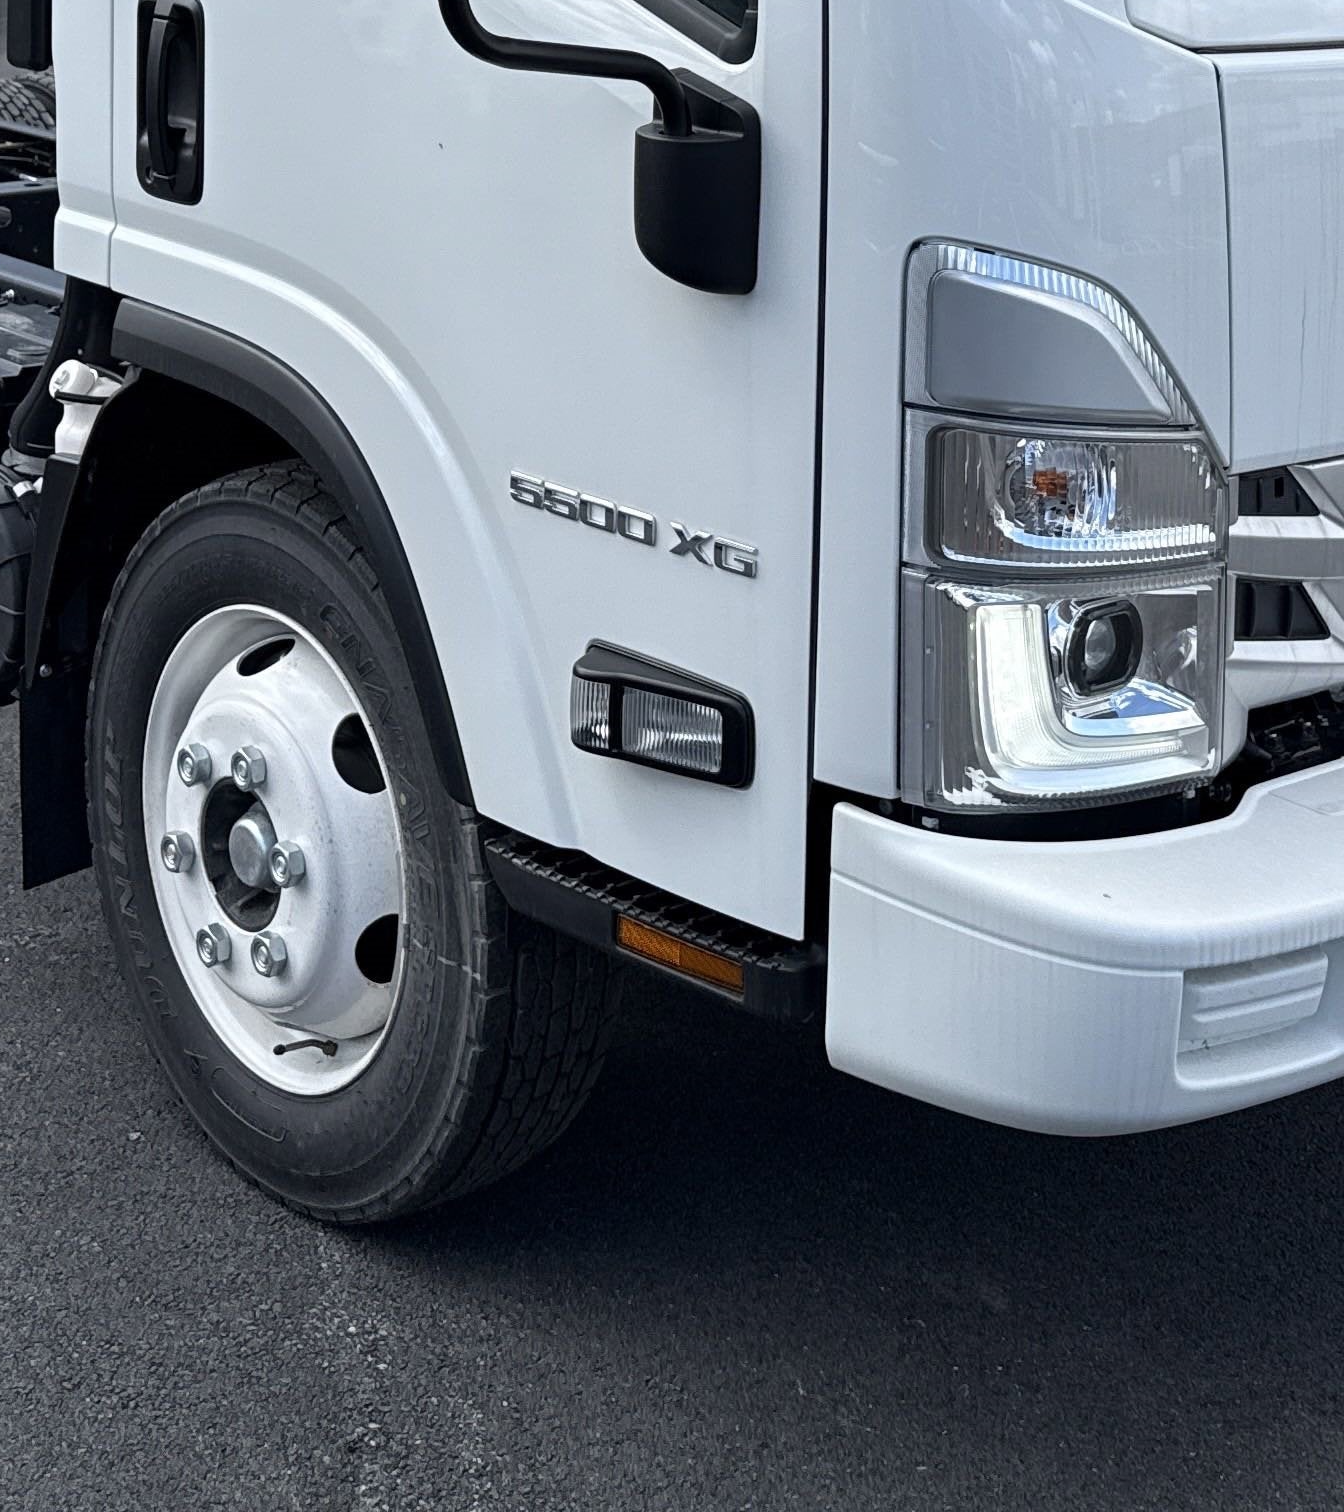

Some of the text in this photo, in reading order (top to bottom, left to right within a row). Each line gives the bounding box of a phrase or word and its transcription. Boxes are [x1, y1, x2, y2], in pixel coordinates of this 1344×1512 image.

[509, 468, 760, 579] 5500 XG
[103, 718, 177, 1025] DUNLOP
